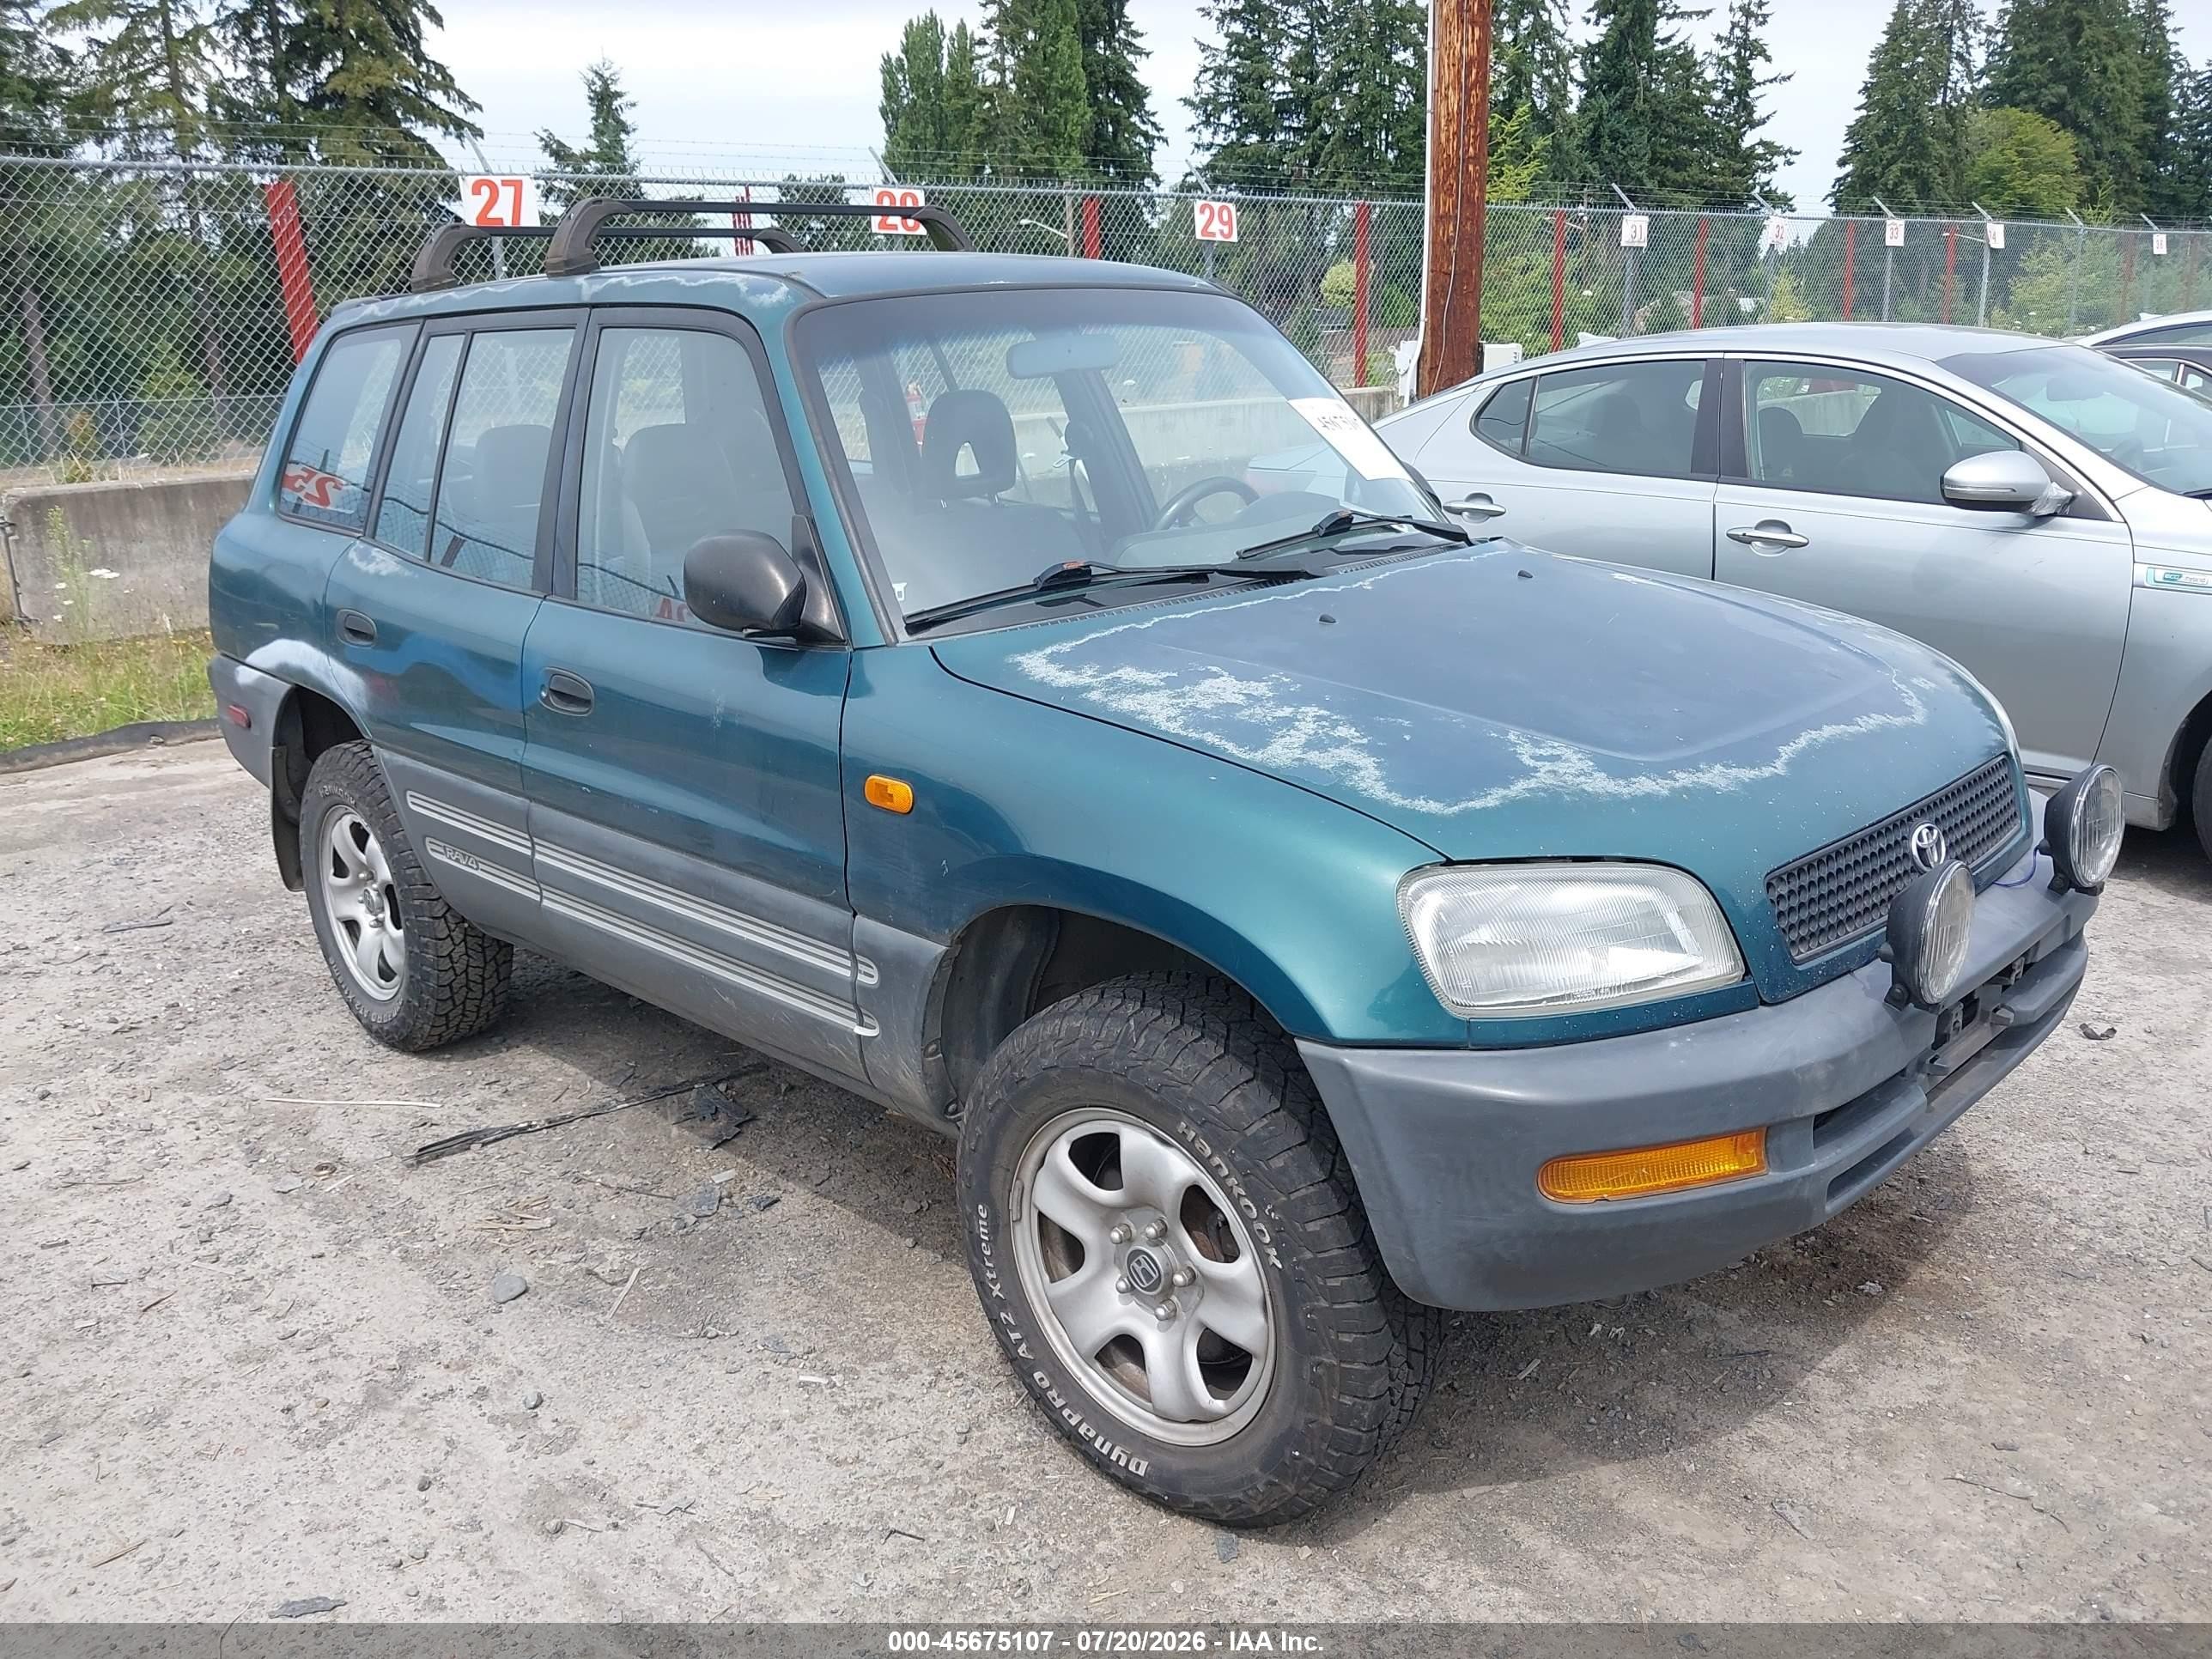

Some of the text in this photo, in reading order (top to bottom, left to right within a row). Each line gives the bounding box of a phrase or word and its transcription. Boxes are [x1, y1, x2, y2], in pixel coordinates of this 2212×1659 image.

[471, 178, 522, 228] 27
[1200, 203, 1233, 239] 29
[1631, 223, 1643, 241] 31
[1889, 226, 1899, 240] 33
[444, 846, 479, 871] RAV4
[977, 1204, 1006, 1300] Xtreme
